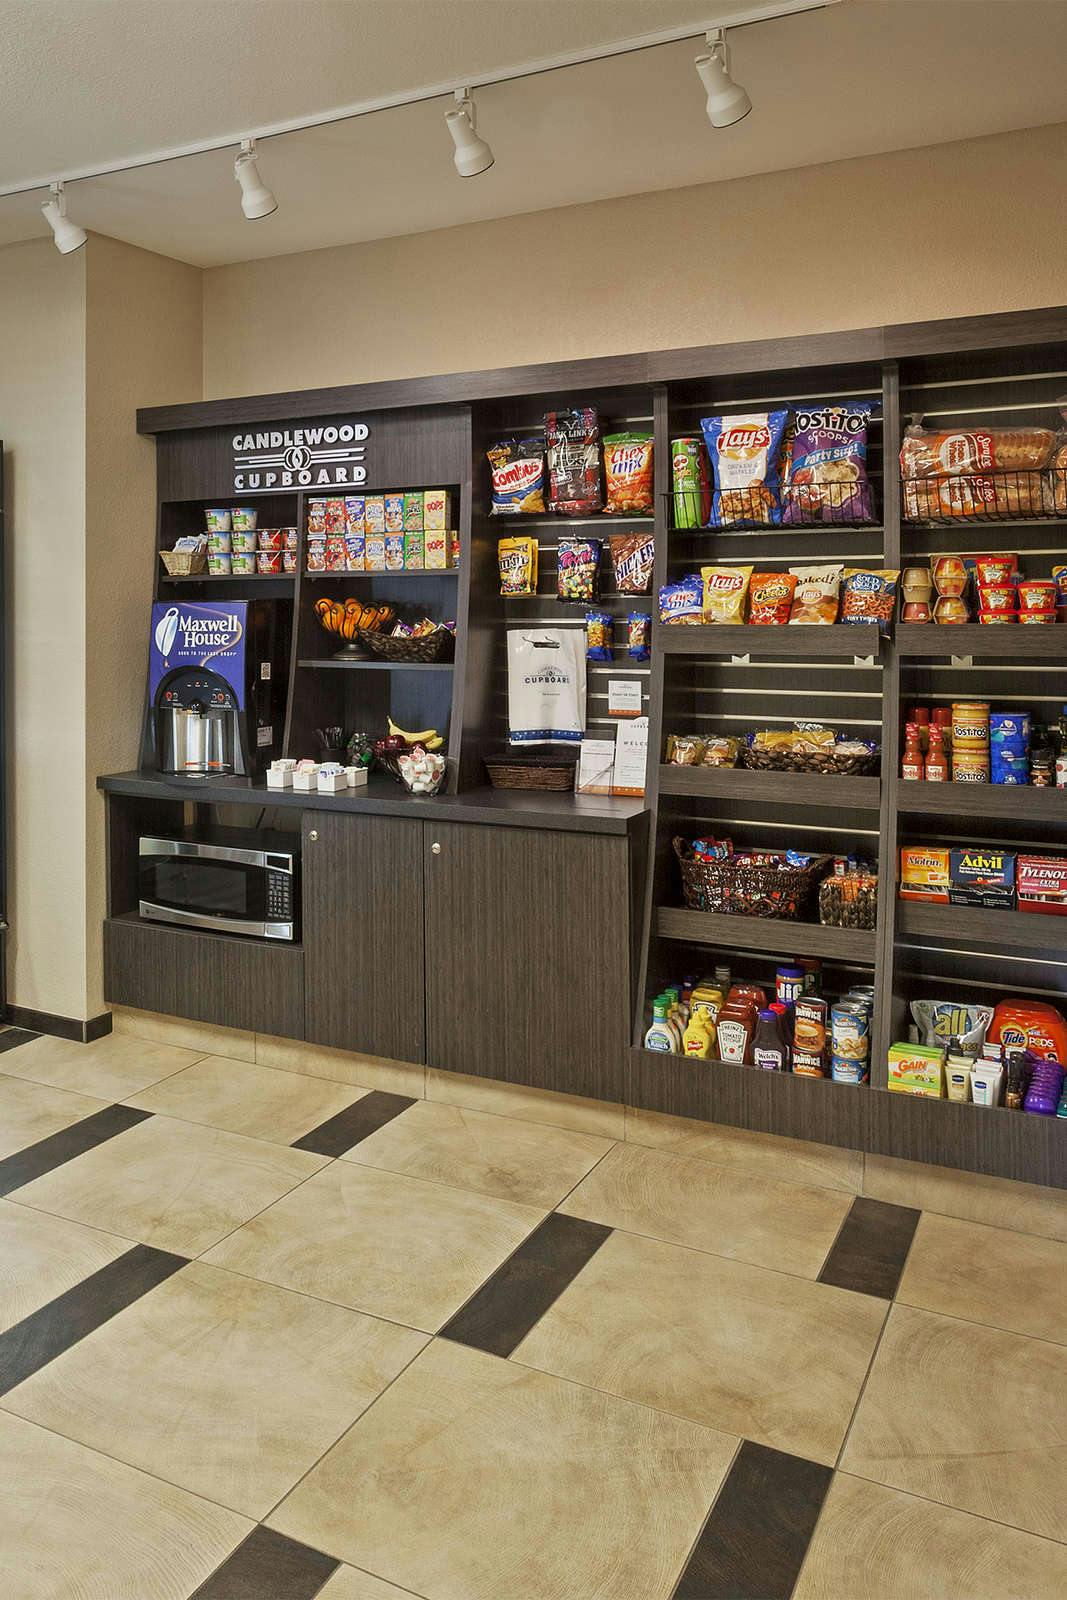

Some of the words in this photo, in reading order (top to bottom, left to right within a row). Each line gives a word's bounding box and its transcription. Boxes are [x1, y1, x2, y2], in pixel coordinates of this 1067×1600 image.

[232, 423, 370, 451] CANDLEWOOD
[234, 466, 368, 489] CUPBOARD
[178, 615, 238, 632] Maxwell
[184, 631, 230, 648] House
[954, 726, 986, 737] TOSTITOS
[955, 770, 986, 781] TOSTITOS
[960, 854, 1003, 869] Advil
[1020, 866, 1067, 880] TYLENOL
[934, 1008, 968, 1036] all
[1003, 1031, 1025, 1044] Tide
[899, 1059, 927, 1072] GAIN
